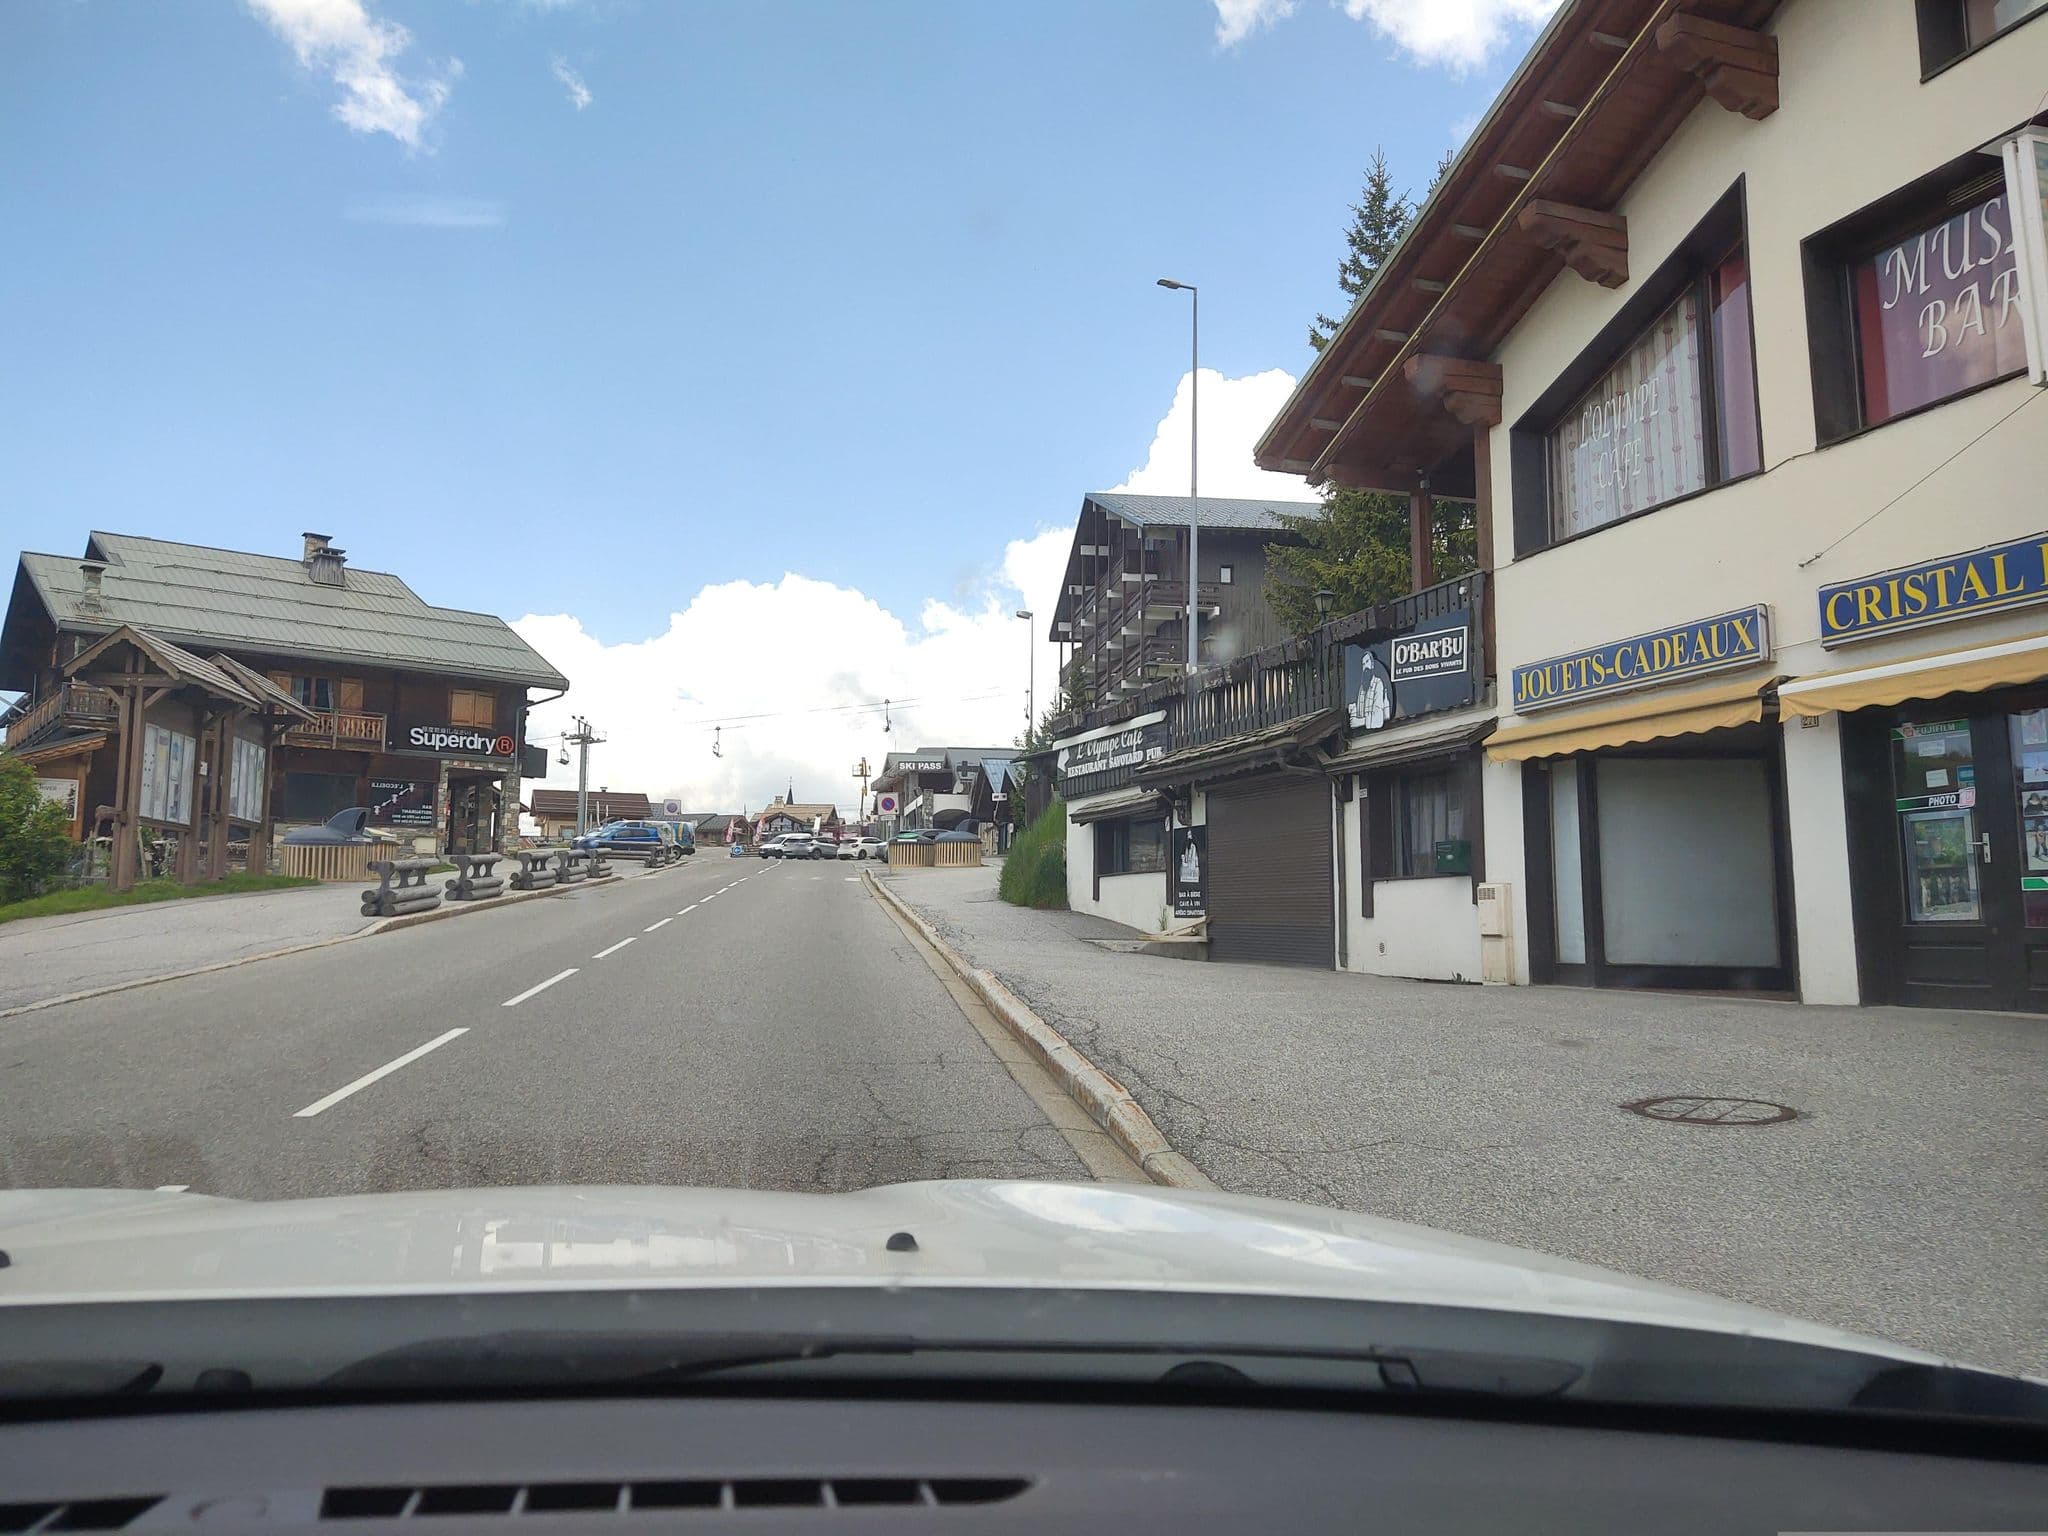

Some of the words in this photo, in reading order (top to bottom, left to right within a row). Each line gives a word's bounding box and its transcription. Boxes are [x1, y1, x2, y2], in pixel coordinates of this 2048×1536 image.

[1883, 197, 2015, 310] MUS
[1580, 377, 1660, 449] L'OLYMPE
[1825, 552, 2025, 631] CRISTAL
[1517, 615, 1757, 702] JOUETS-CADEAUX
[899, 762, 916, 770] SKI
[918, 762, 942, 770] PASS
[1067, 759, 1109, 778] RESTAURANT
[1108, 750, 1144, 769] SAVOYARD
[1928, 795, 1957, 806] PHOTO
